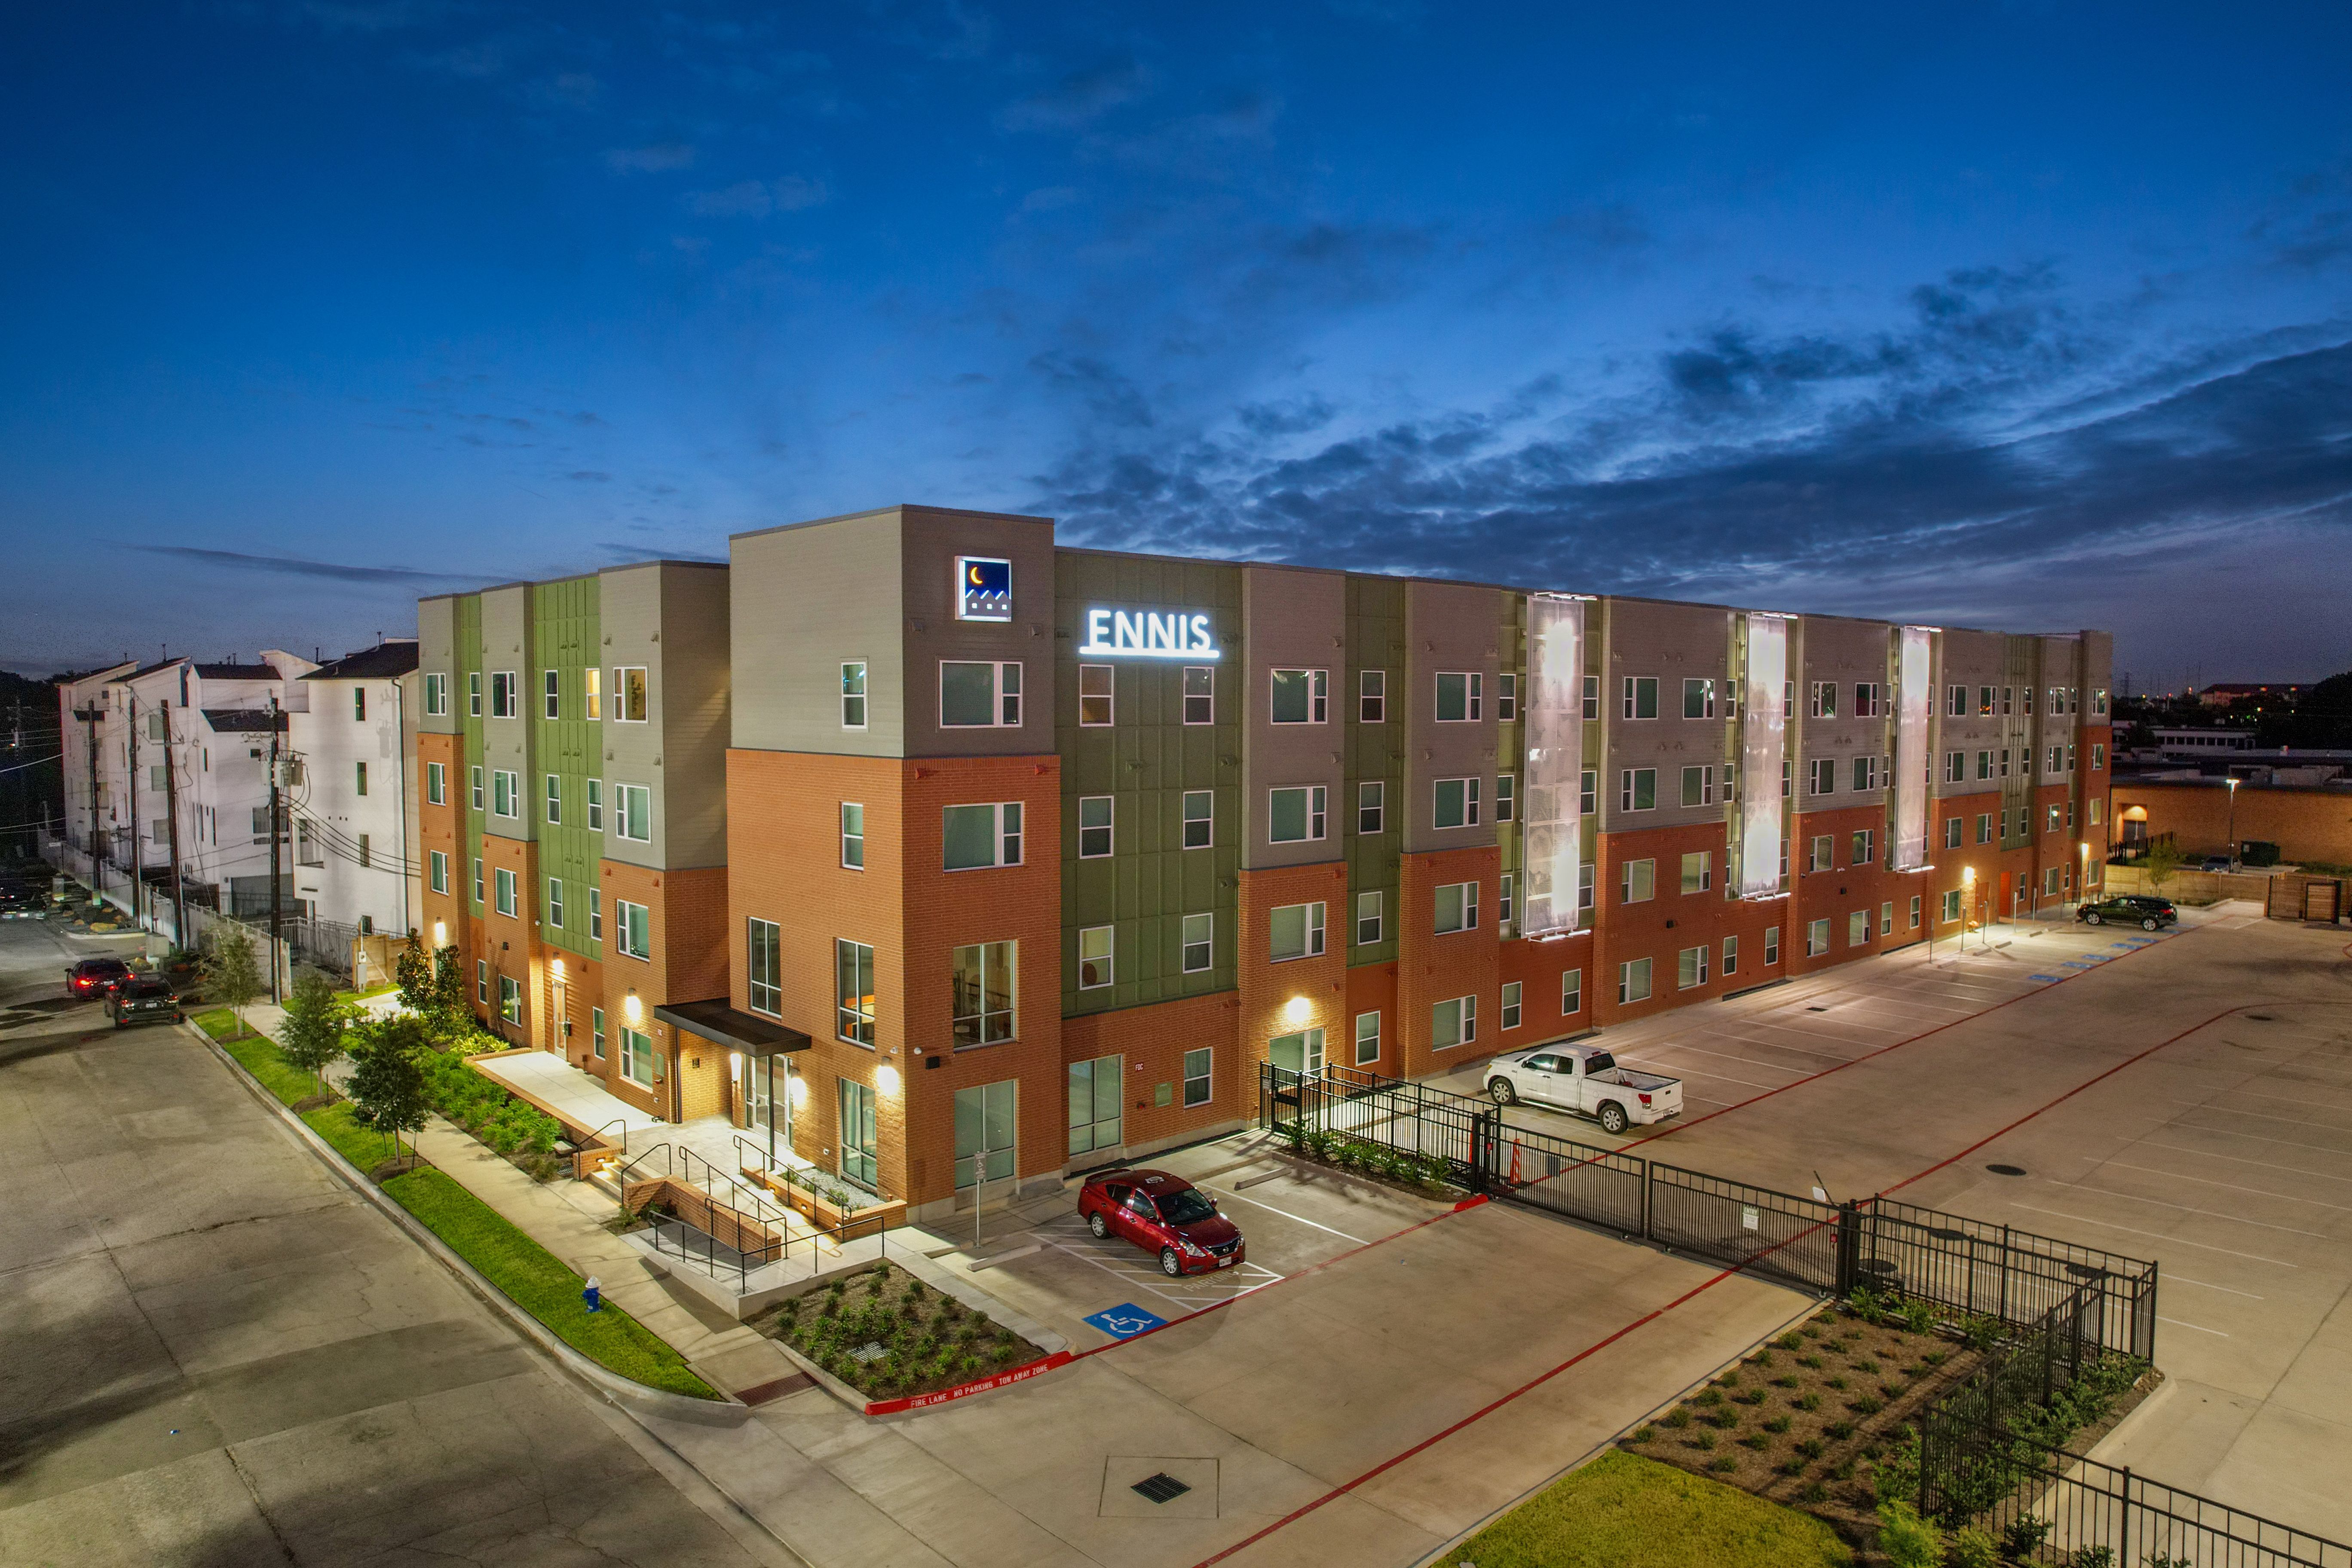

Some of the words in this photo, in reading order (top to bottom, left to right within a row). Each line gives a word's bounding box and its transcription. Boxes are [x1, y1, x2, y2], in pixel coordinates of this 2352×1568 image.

[1089, 609, 1211, 651] ENNIS
[1744, 1207, 1757, 1216] ENTRY
[1183, 1270, 1239, 1292] PARKING
[910, 1396, 926, 1408] FIRE
[929, 1393, 946, 1404] LANE
[953, 1389, 963, 1397] NO
[965, 1381, 993, 1395] PARKING
[999, 1375, 1011, 1385] TOW
[1014, 1370, 1030, 1381] AWAY
[1032, 1364, 1048, 1375] ZONE
